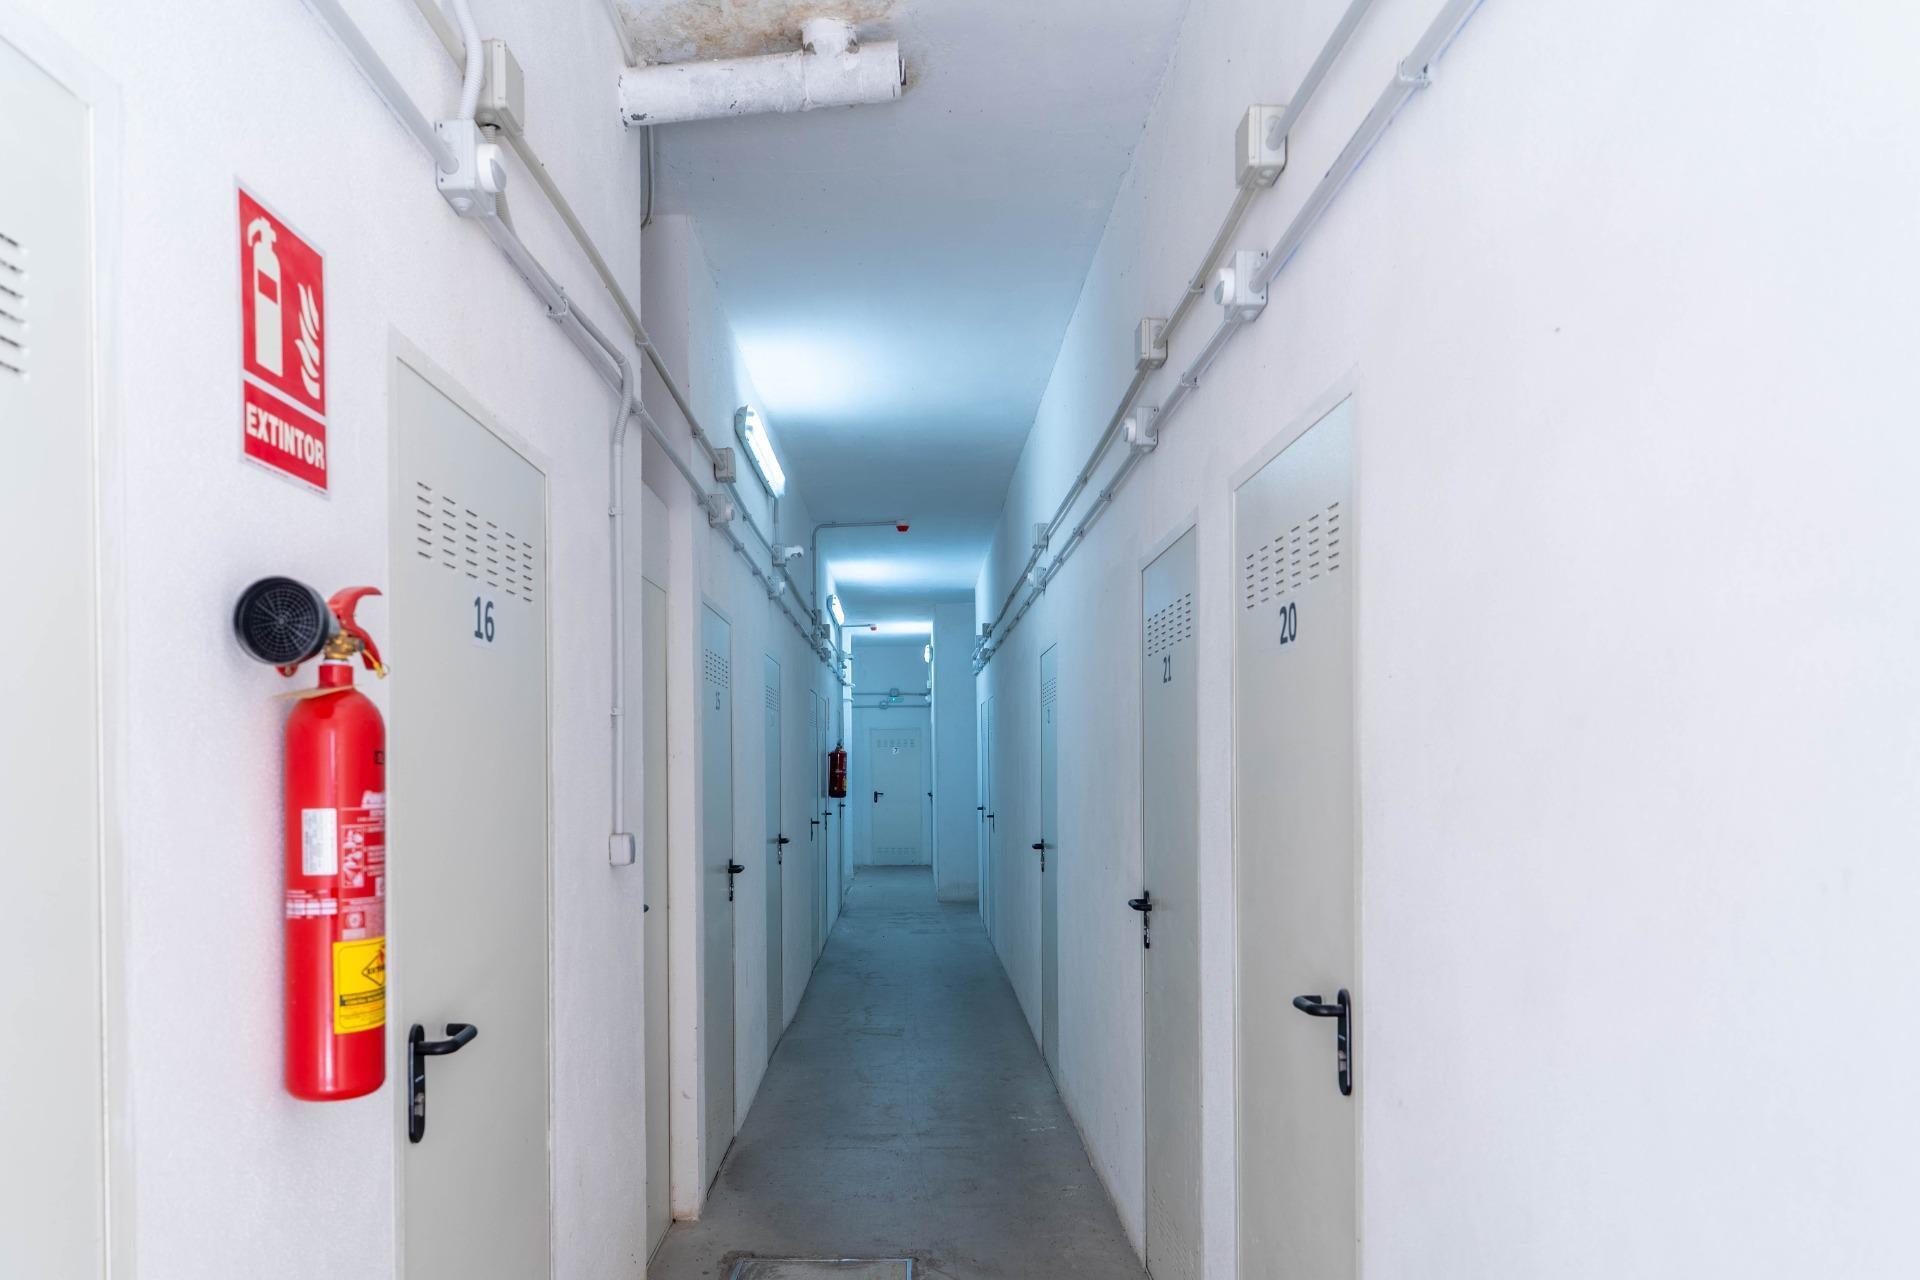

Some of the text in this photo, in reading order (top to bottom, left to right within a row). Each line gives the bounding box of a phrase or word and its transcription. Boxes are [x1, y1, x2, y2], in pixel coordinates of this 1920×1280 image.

[245, 401, 325, 471] EXTINTOR
[474, 596, 495, 643] 16
[1279, 601, 1297, 645] 20
[1163, 655, 1172, 684] 21
